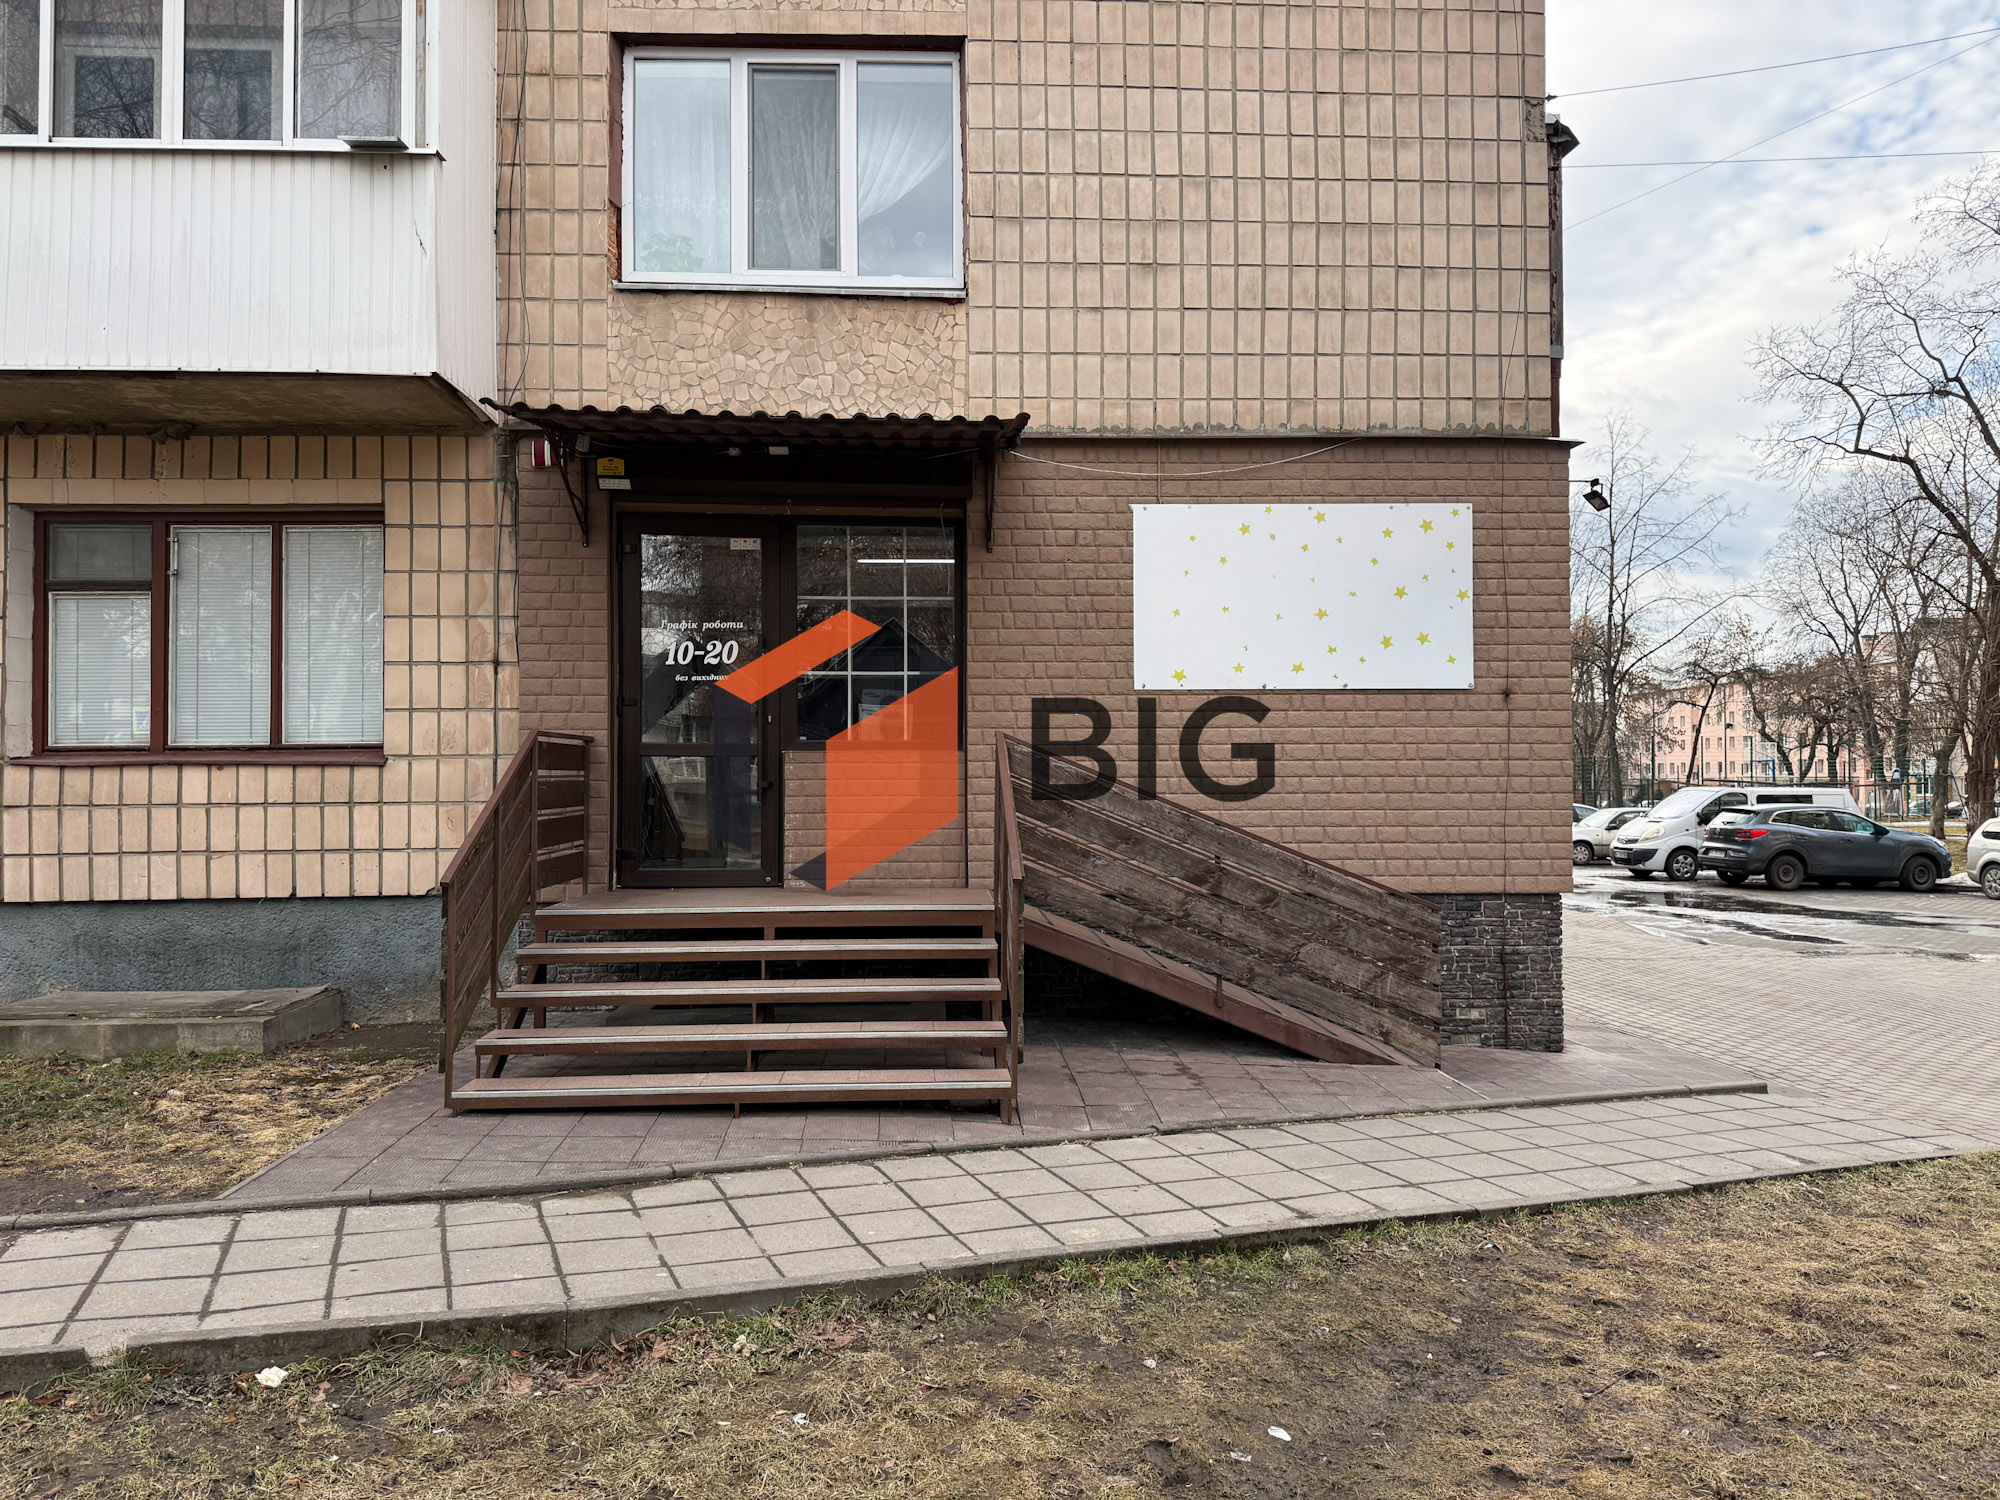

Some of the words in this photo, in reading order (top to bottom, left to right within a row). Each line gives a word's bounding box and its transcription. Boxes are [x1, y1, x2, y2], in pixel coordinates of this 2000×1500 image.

[660, 619, 698, 632] Графік
[702, 619, 744, 632] роботи
[665, 640, 739, 665] 10-20
[675, 674, 689, 682] без
